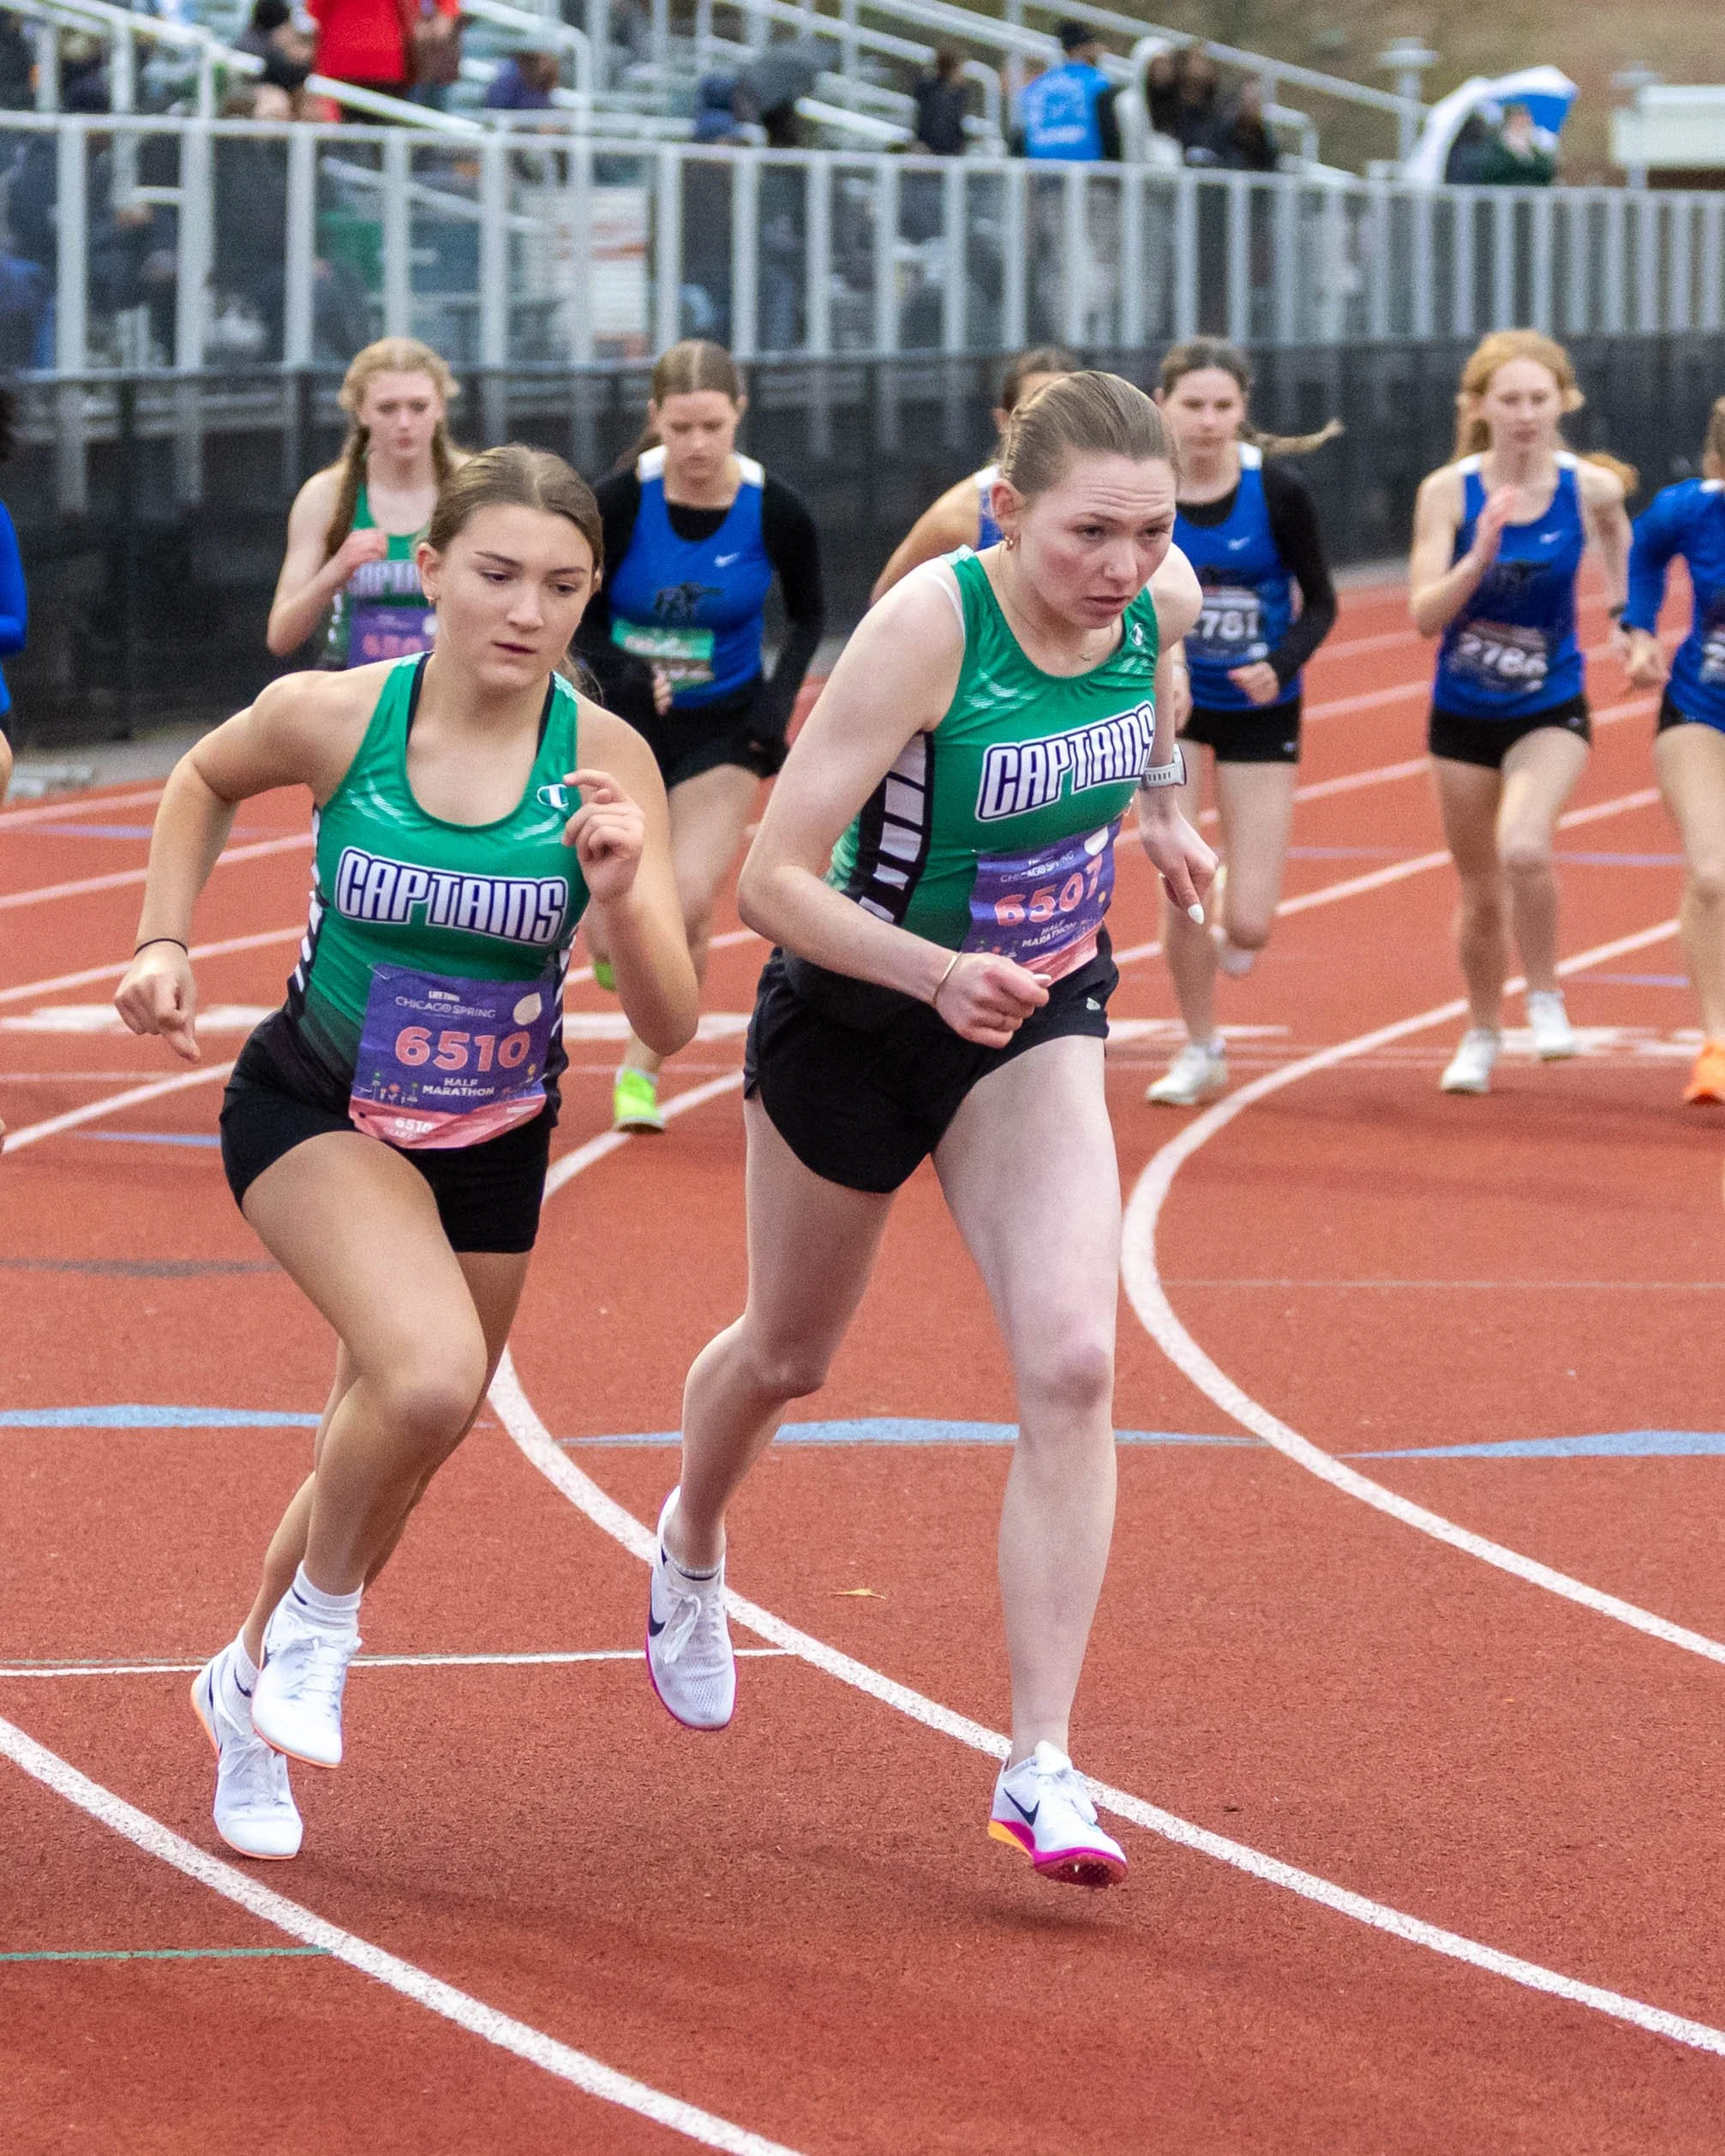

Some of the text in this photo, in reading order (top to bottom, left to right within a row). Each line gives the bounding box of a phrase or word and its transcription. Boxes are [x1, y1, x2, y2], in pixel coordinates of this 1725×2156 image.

[974, 699, 1155, 823] CAPTAINS
[334, 846, 569, 946] CAPTAINS
[395, 996, 452, 1014] CHICAGO
[451, 1004, 496, 1019] SPRING
[394, 1026, 531, 1073] 6510
[422, 1085, 495, 1097] MARATHON
[444, 1077, 478, 1087] HALF
